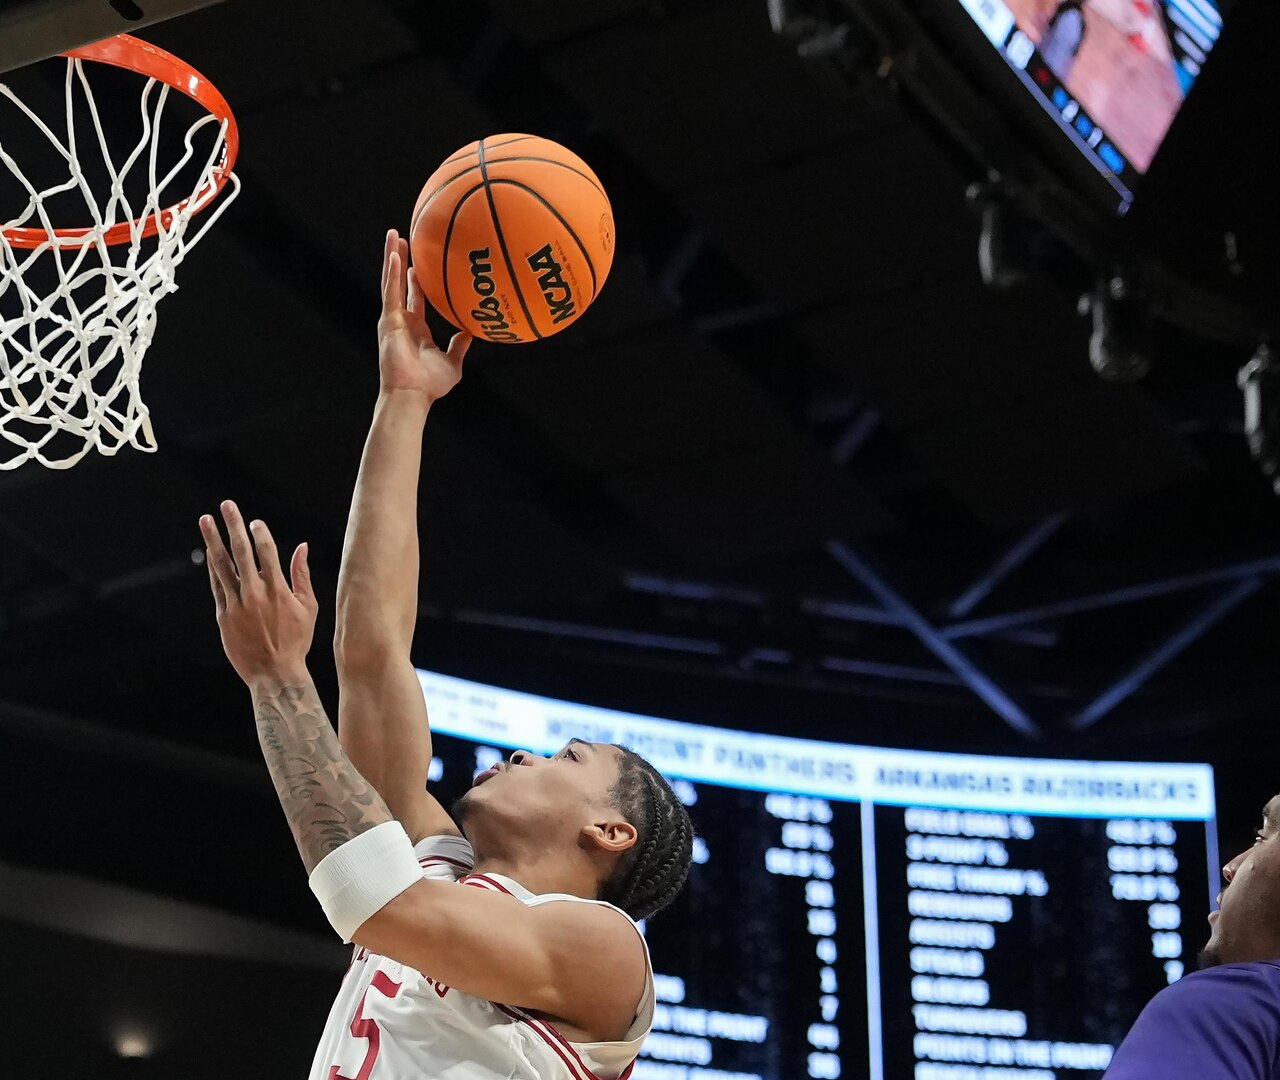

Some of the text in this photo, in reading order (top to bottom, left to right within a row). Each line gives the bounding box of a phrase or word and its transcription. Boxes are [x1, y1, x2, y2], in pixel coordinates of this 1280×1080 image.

[526, 242, 576, 325] NCAA
[713, 741, 857, 786] PANTHERS
[873, 764, 1202, 802] ARKANSAS RAZORBACKS
